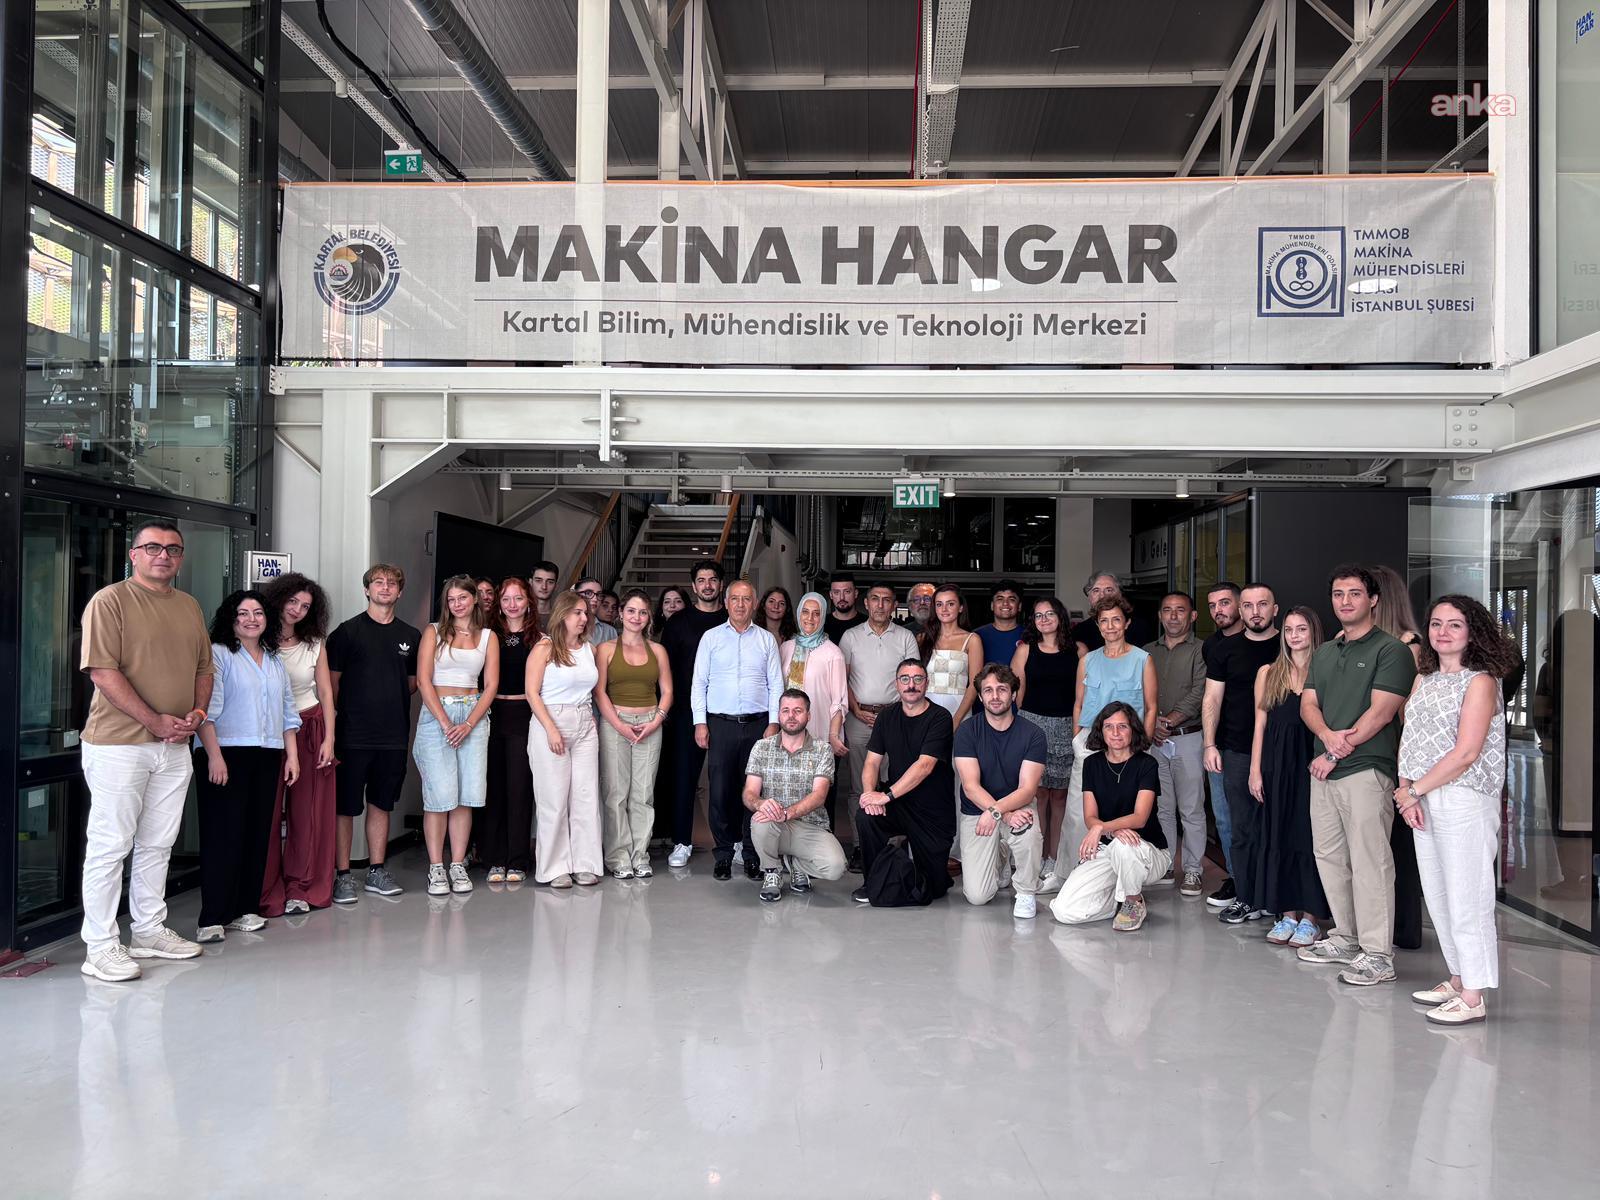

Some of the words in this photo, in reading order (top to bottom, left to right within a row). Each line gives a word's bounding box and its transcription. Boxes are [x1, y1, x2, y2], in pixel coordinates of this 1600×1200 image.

[1353, 228, 1410, 241] TMMOB
[313, 231, 347, 271] KARTAL
[349, 229, 402, 270] BELEDİYESİ
[474, 206, 801, 285] MAKİNA
[821, 223, 1178, 286] HANGAR
[1354, 243, 1413, 258] MAKİNA
[1353, 260, 1466, 277] MÜHENDİSLERİ
[1351, 298, 1424, 313] İSTANBUL
[1427, 298, 1475, 314] ŞUBESİ
[503, 310, 588, 334] Kartal
[598, 310, 675, 339] Bilim,
[684, 311, 849, 337] Mühendislik
[858, 317, 888, 335] ve
[897, 311, 1024, 342] Teknoloji
[1033, 312, 1147, 335] Merkezi
[895, 485, 937, 506] EXIT
[257, 558, 282, 568] HAN-
[262, 568, 282, 577] GAR
